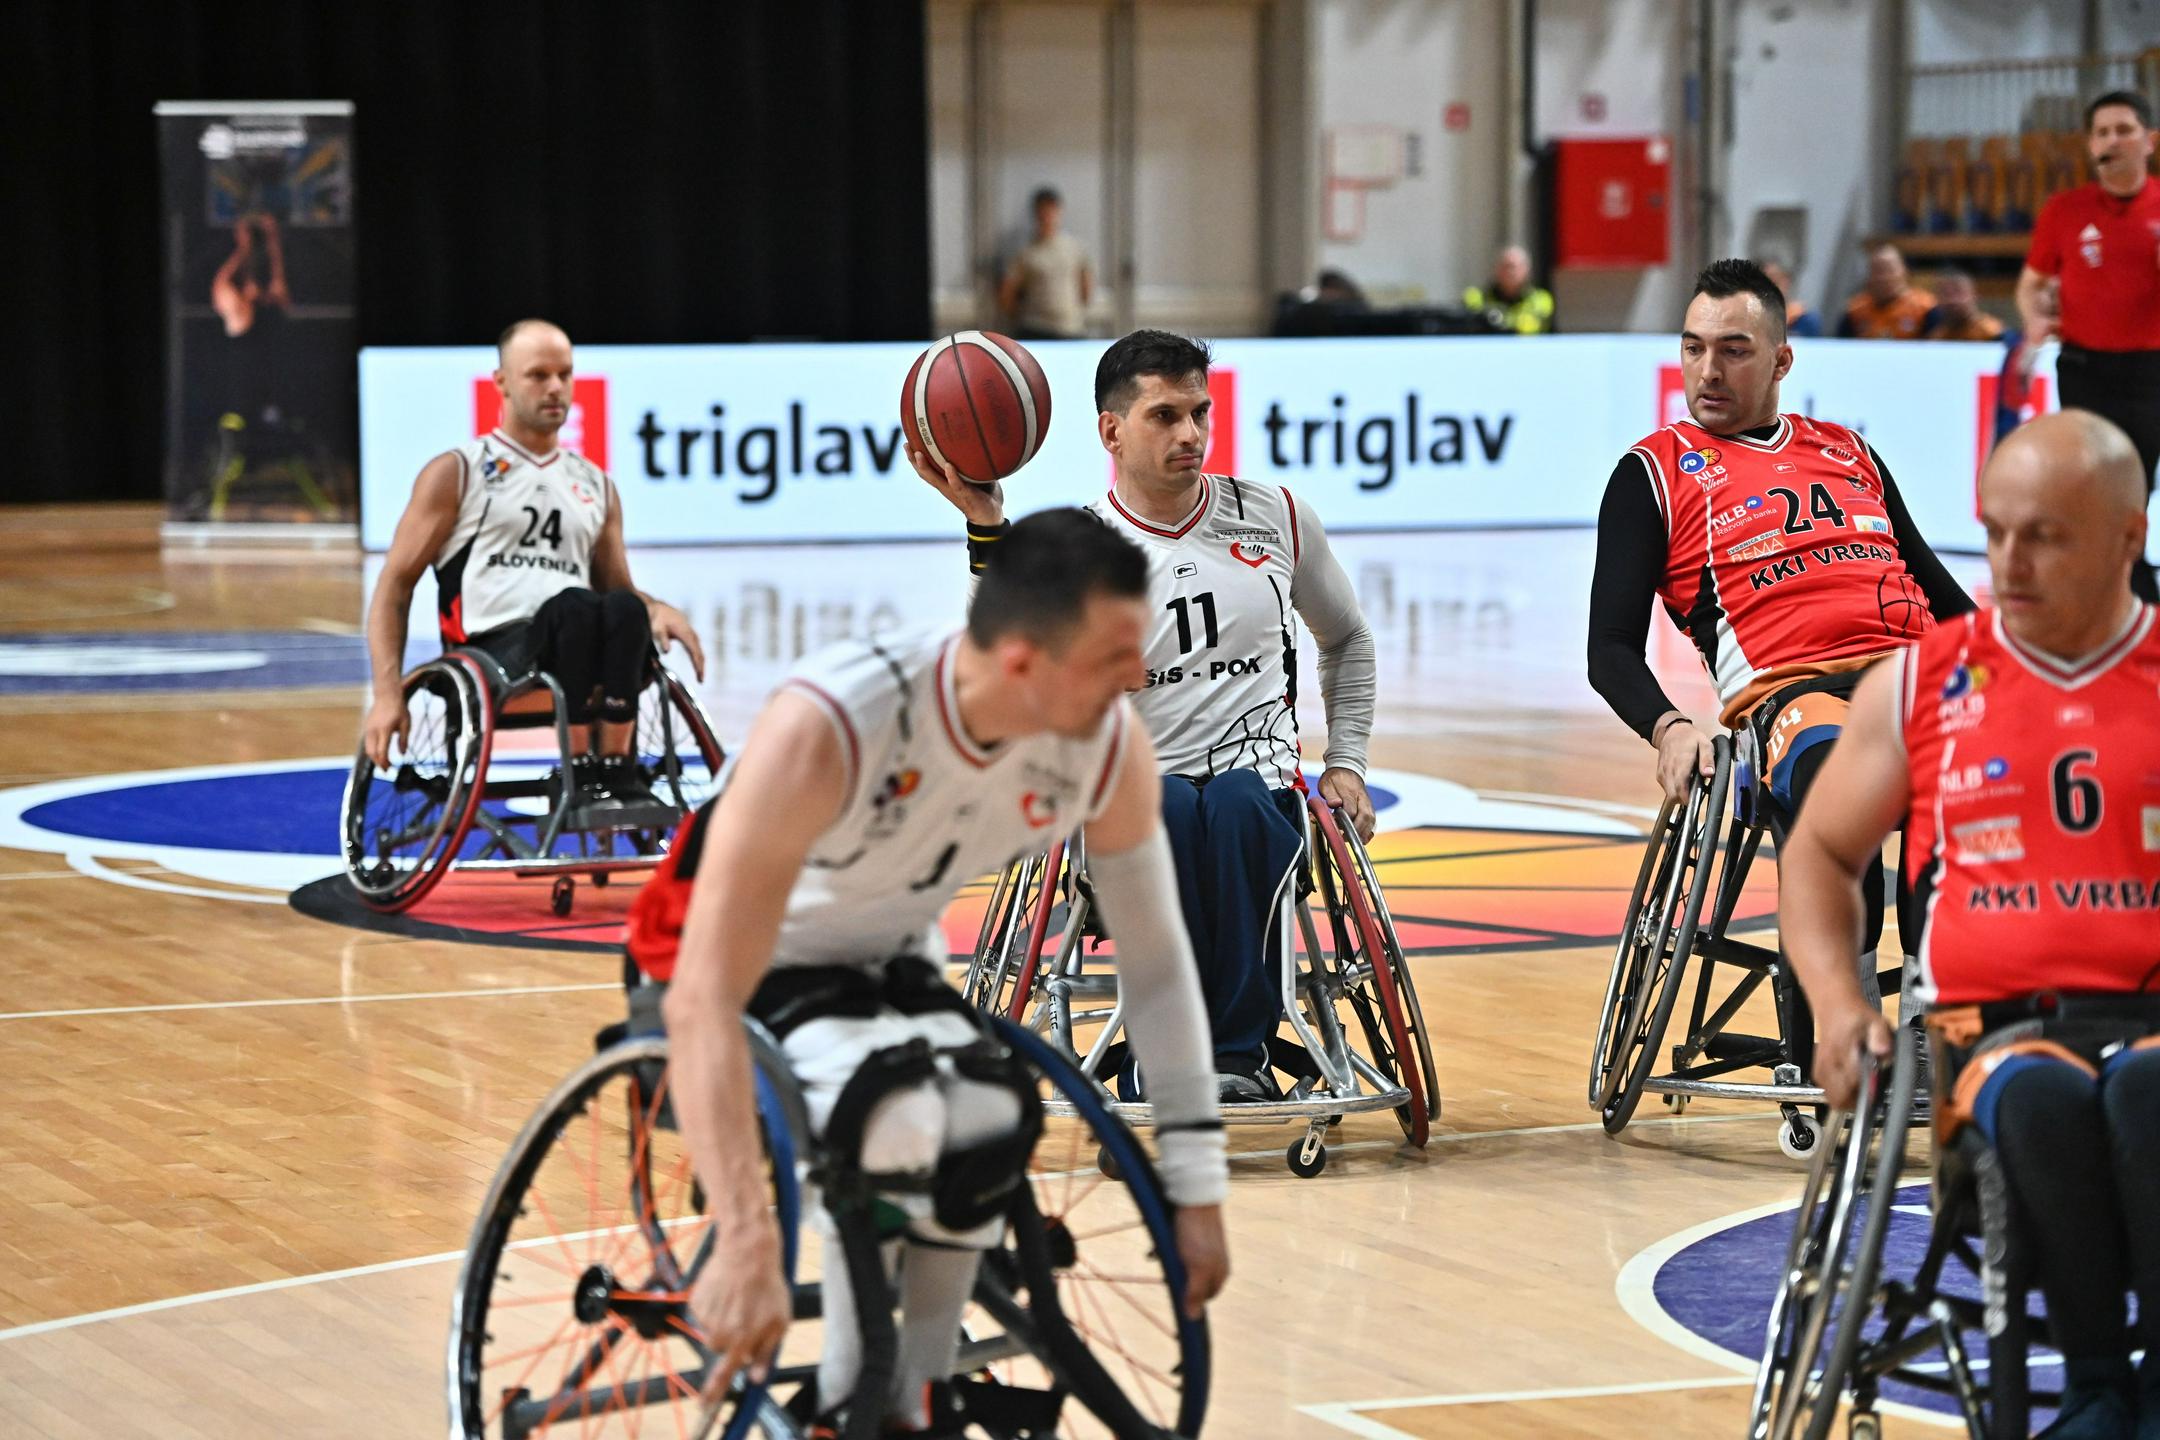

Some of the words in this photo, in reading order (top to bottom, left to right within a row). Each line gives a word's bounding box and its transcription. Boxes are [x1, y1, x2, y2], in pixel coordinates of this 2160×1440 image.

[635, 401, 901, 504] triglav
[1264, 392, 1513, 491] triglav
[1694, 465, 1726, 485] NLB
[519, 506, 562, 550] 24
[1712, 505, 1748, 530] NLB
[1716, 515, 1753, 537] Razvojna
[1753, 507, 1778, 520] banka
[1766, 482, 1847, 536] 24
[1731, 537, 1784, 563] BEMA
[1749, 554, 1807, 592] KKI
[1166, 591, 1219, 655] 11
[1210, 655, 1262, 681] POK
[2049, 746, 2105, 836] 6
[1968, 882, 2040, 912] KKI
